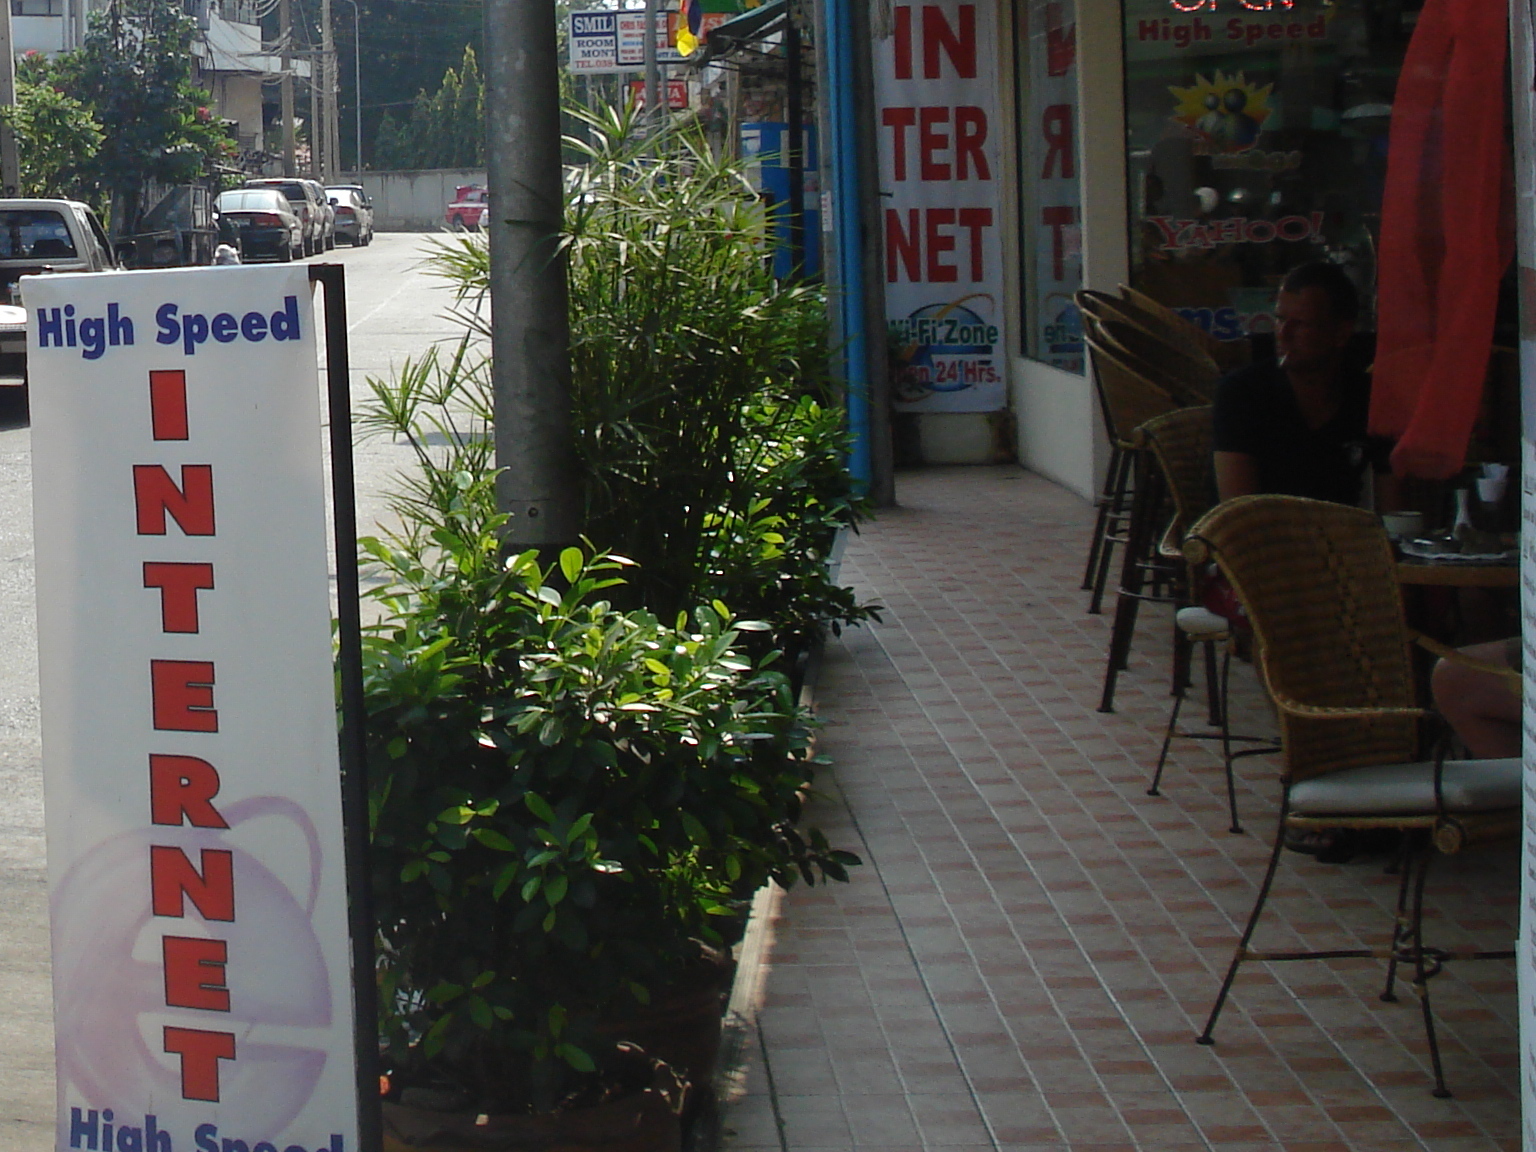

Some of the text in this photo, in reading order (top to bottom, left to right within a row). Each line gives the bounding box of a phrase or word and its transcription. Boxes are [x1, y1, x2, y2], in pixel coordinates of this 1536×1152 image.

[893, 5, 978, 80] IN
[1138, 14, 1327, 48] High Speed
[882, 106, 991, 182] TER
[885, 207, 993, 284] NET
[37, 295, 302, 361] High Speed
[943, 318, 999, 345] Zone
[935, 360, 958, 383] 24
[964, 359, 1002, 384] Hrs.
[132, 367, 237, 1104] INTERNET
